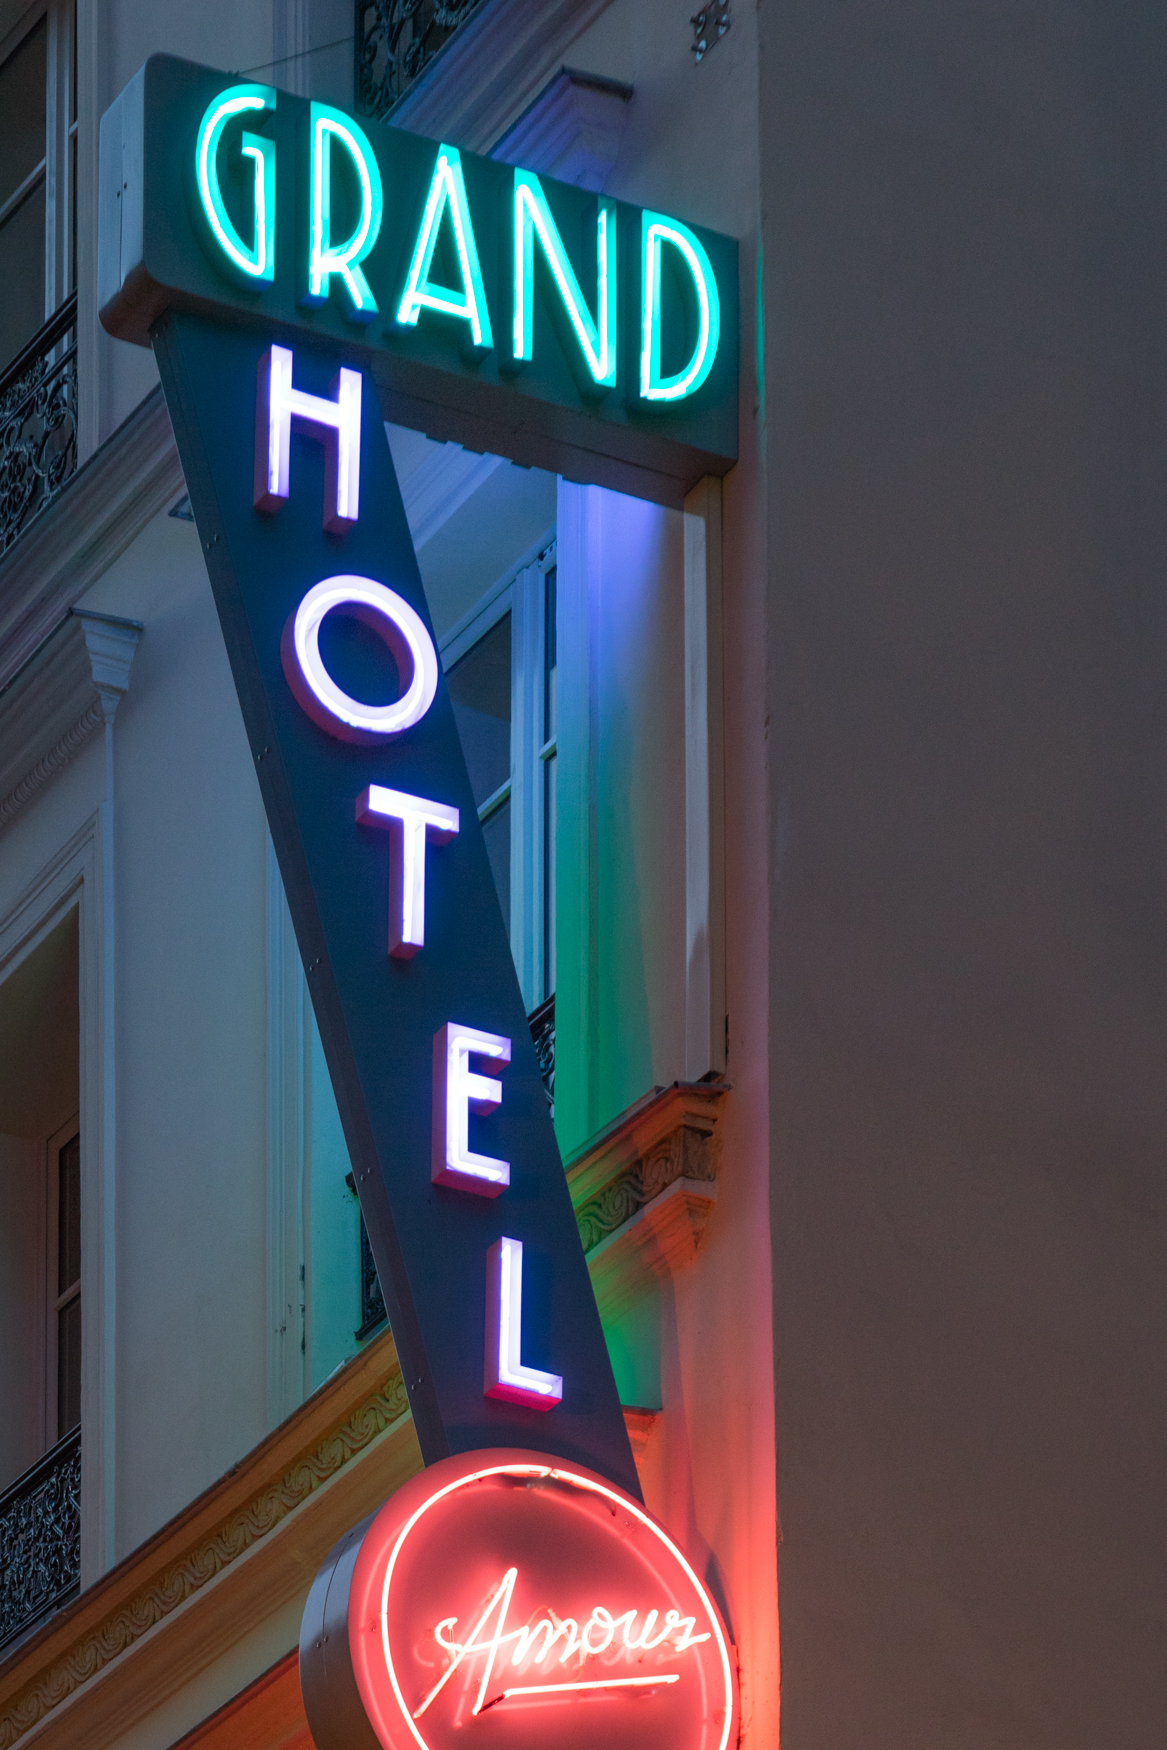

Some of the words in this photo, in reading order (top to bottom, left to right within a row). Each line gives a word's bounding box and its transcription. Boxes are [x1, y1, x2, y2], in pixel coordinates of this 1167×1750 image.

[195, 83, 720, 400] GRAND
[254, 344, 563, 1411] HOTEL
[412, 1566, 712, 1720] Amour
